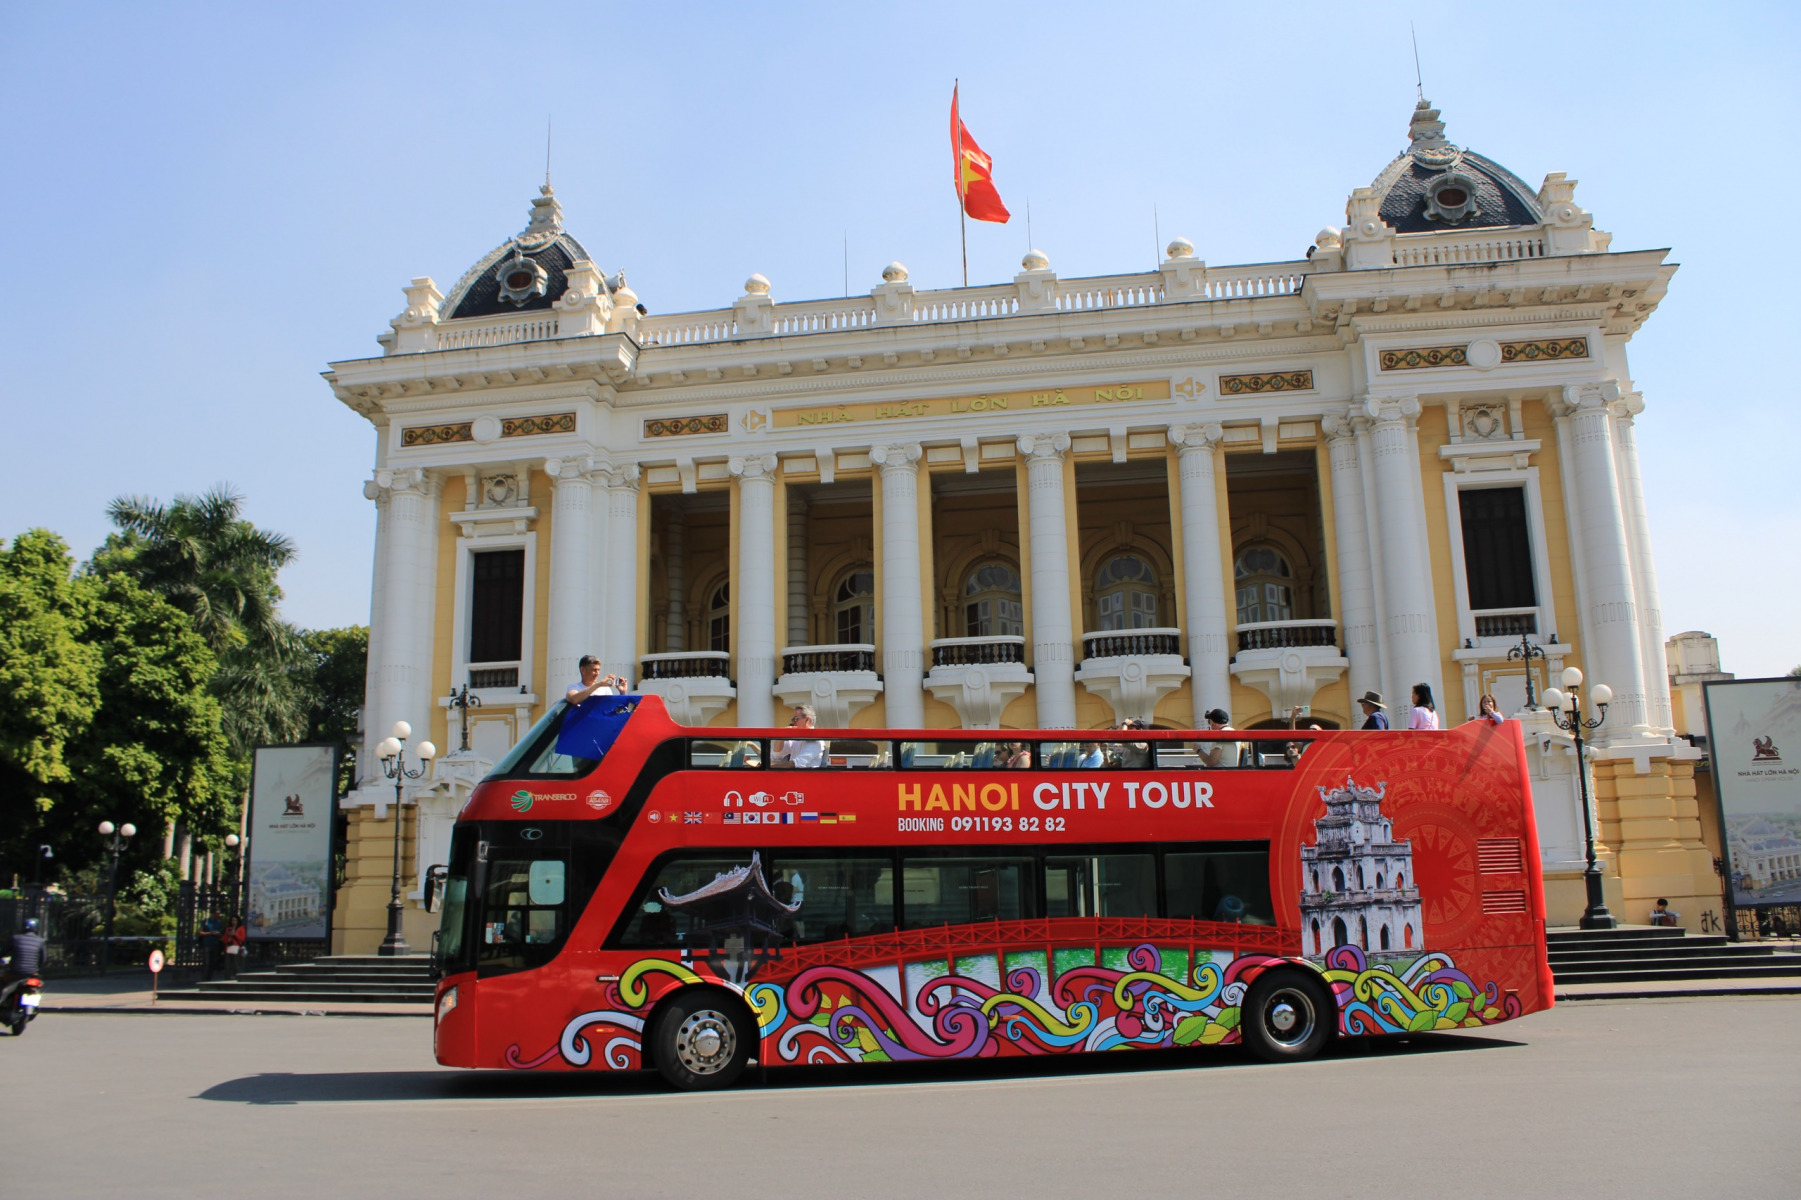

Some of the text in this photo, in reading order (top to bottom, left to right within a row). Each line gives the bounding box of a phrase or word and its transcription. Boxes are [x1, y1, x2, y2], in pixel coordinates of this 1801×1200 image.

[797, 404, 854, 426] NHÀ
[875, 400, 929, 419] HÁT
[1032, 388, 1070, 407] HÀ
[533, 793, 577, 801] TRANSERCO
[898, 781, 1215, 811] HANOI CITY TOUR
[898, 816, 1066, 832] BOOKING 091193 82 82
